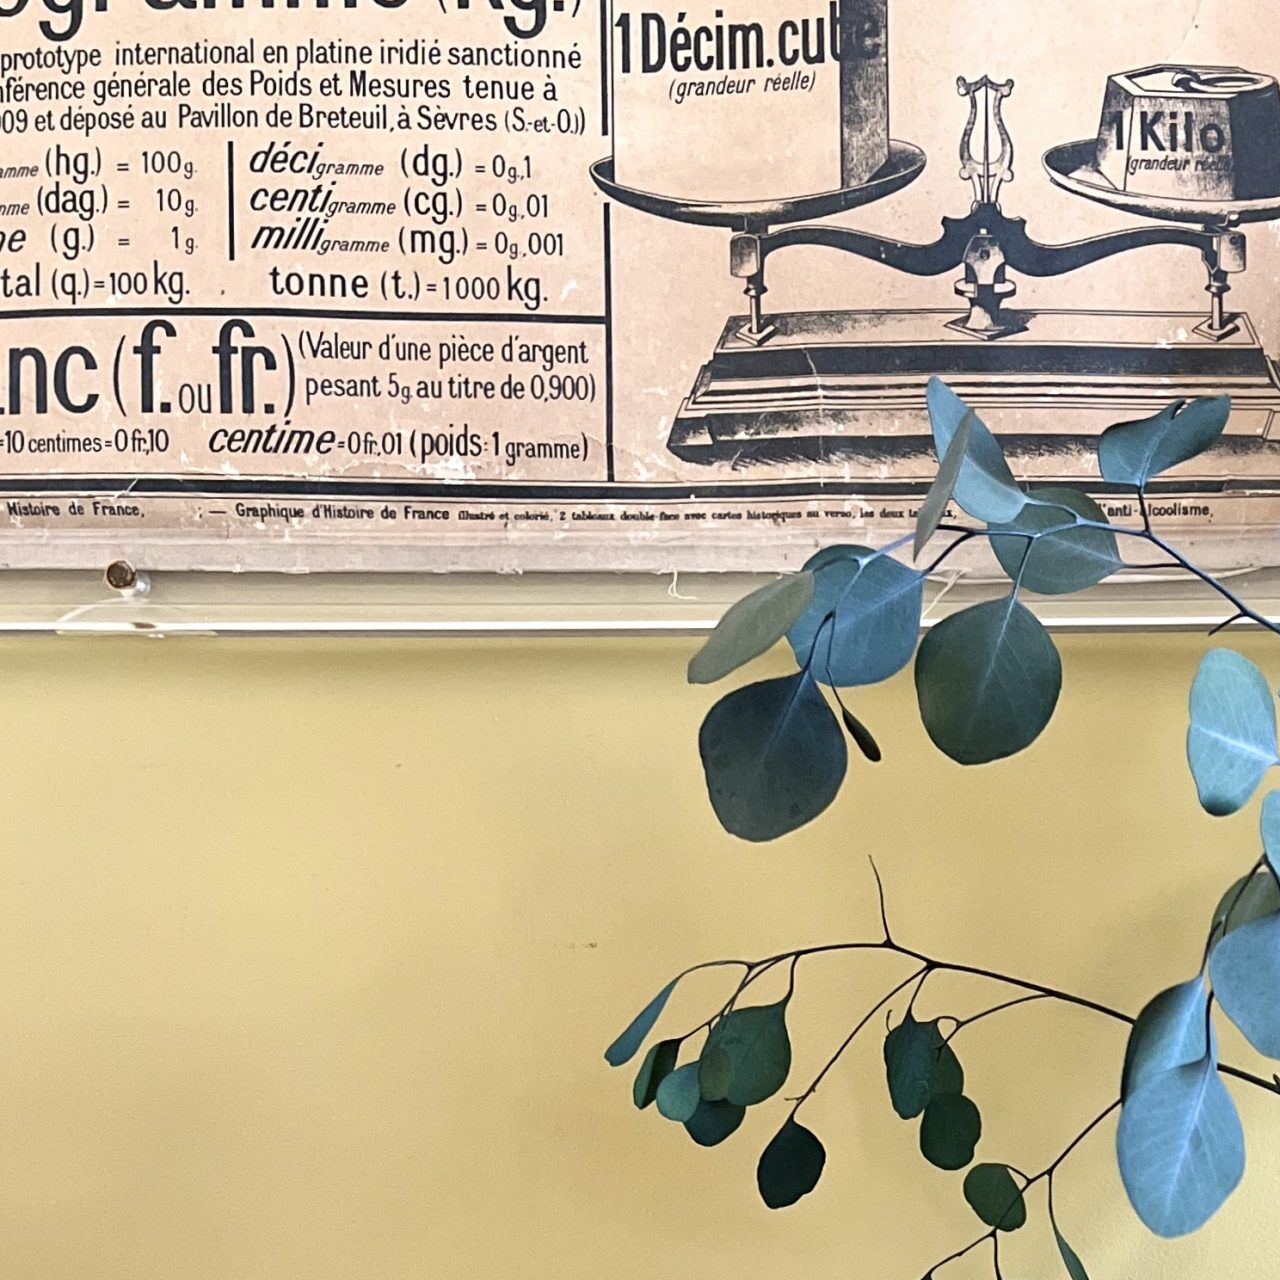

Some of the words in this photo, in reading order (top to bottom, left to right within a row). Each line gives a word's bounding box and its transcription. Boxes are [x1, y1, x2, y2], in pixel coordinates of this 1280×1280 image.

[0, 45, 102, 80] prototype
[115, 37, 255, 66] international
[262, 45, 288, 64] en
[296, 37, 373, 72] platine
[380, 38, 442, 66] iridié
[447, 40, 582, 70] sanctionné
[92, 70, 191, 107] générale
[202, 69, 243, 97] des
[249, 67, 313, 97] Poids
[319, 72, 343, 97] et
[349, 69, 451, 99] Mesures
[462, 74, 535, 101] tenue
[542, 73, 559, 102] à
[668, 74, 756, 105] (grandeur
[763, 70, 816, 93] réelle)
[0, 108, 29, 135] 09
[34, 109, 56, 133] et
[59, 103, 135, 138] déposé
[141, 110, 167, 129] au
[178, 102, 259, 129] Pavillon
[265, 102, 293, 128] de
[396, 104, 413, 130] à
[416, 104, 498, 132] Sèvres
[1138, 110, 1226, 154] Kilo
[45, 143, 102, 186] (hg.)
[400, 143, 463, 187] (dg.)
[37, 179, 108, 222] (dag.)
[403, 186, 463, 226] (cg.)
[50, 222, 95, 261] (g.)
[398, 226, 469, 265] (mg.)
[0, 261, 41, 298] tal
[268, 265, 369, 299] tonne
[298, 329, 373, 360] (Valeur
[378, 333, 432, 362] d'une
[438, 334, 495, 370] pièce
[501, 334, 590, 372] d'argent
[0, 345, 100, 416] nc
[305, 375, 382, 406] pesant
[416, 380, 443, 399] au
[447, 373, 496, 400] titre
[500, 373, 526, 400] de
[530, 372, 596, 403] 0,900)
[505, 431, 589, 467] gramme)
[68, 502, 85, 516] de
[91, 500, 145, 519] France,
[235, 502, 305, 524] Graphique
[311, 504, 375, 520] d'Histoire
[380, 504, 397, 520] de
[403, 504, 450, 521] France
[559, 510, 567, 522] 2
